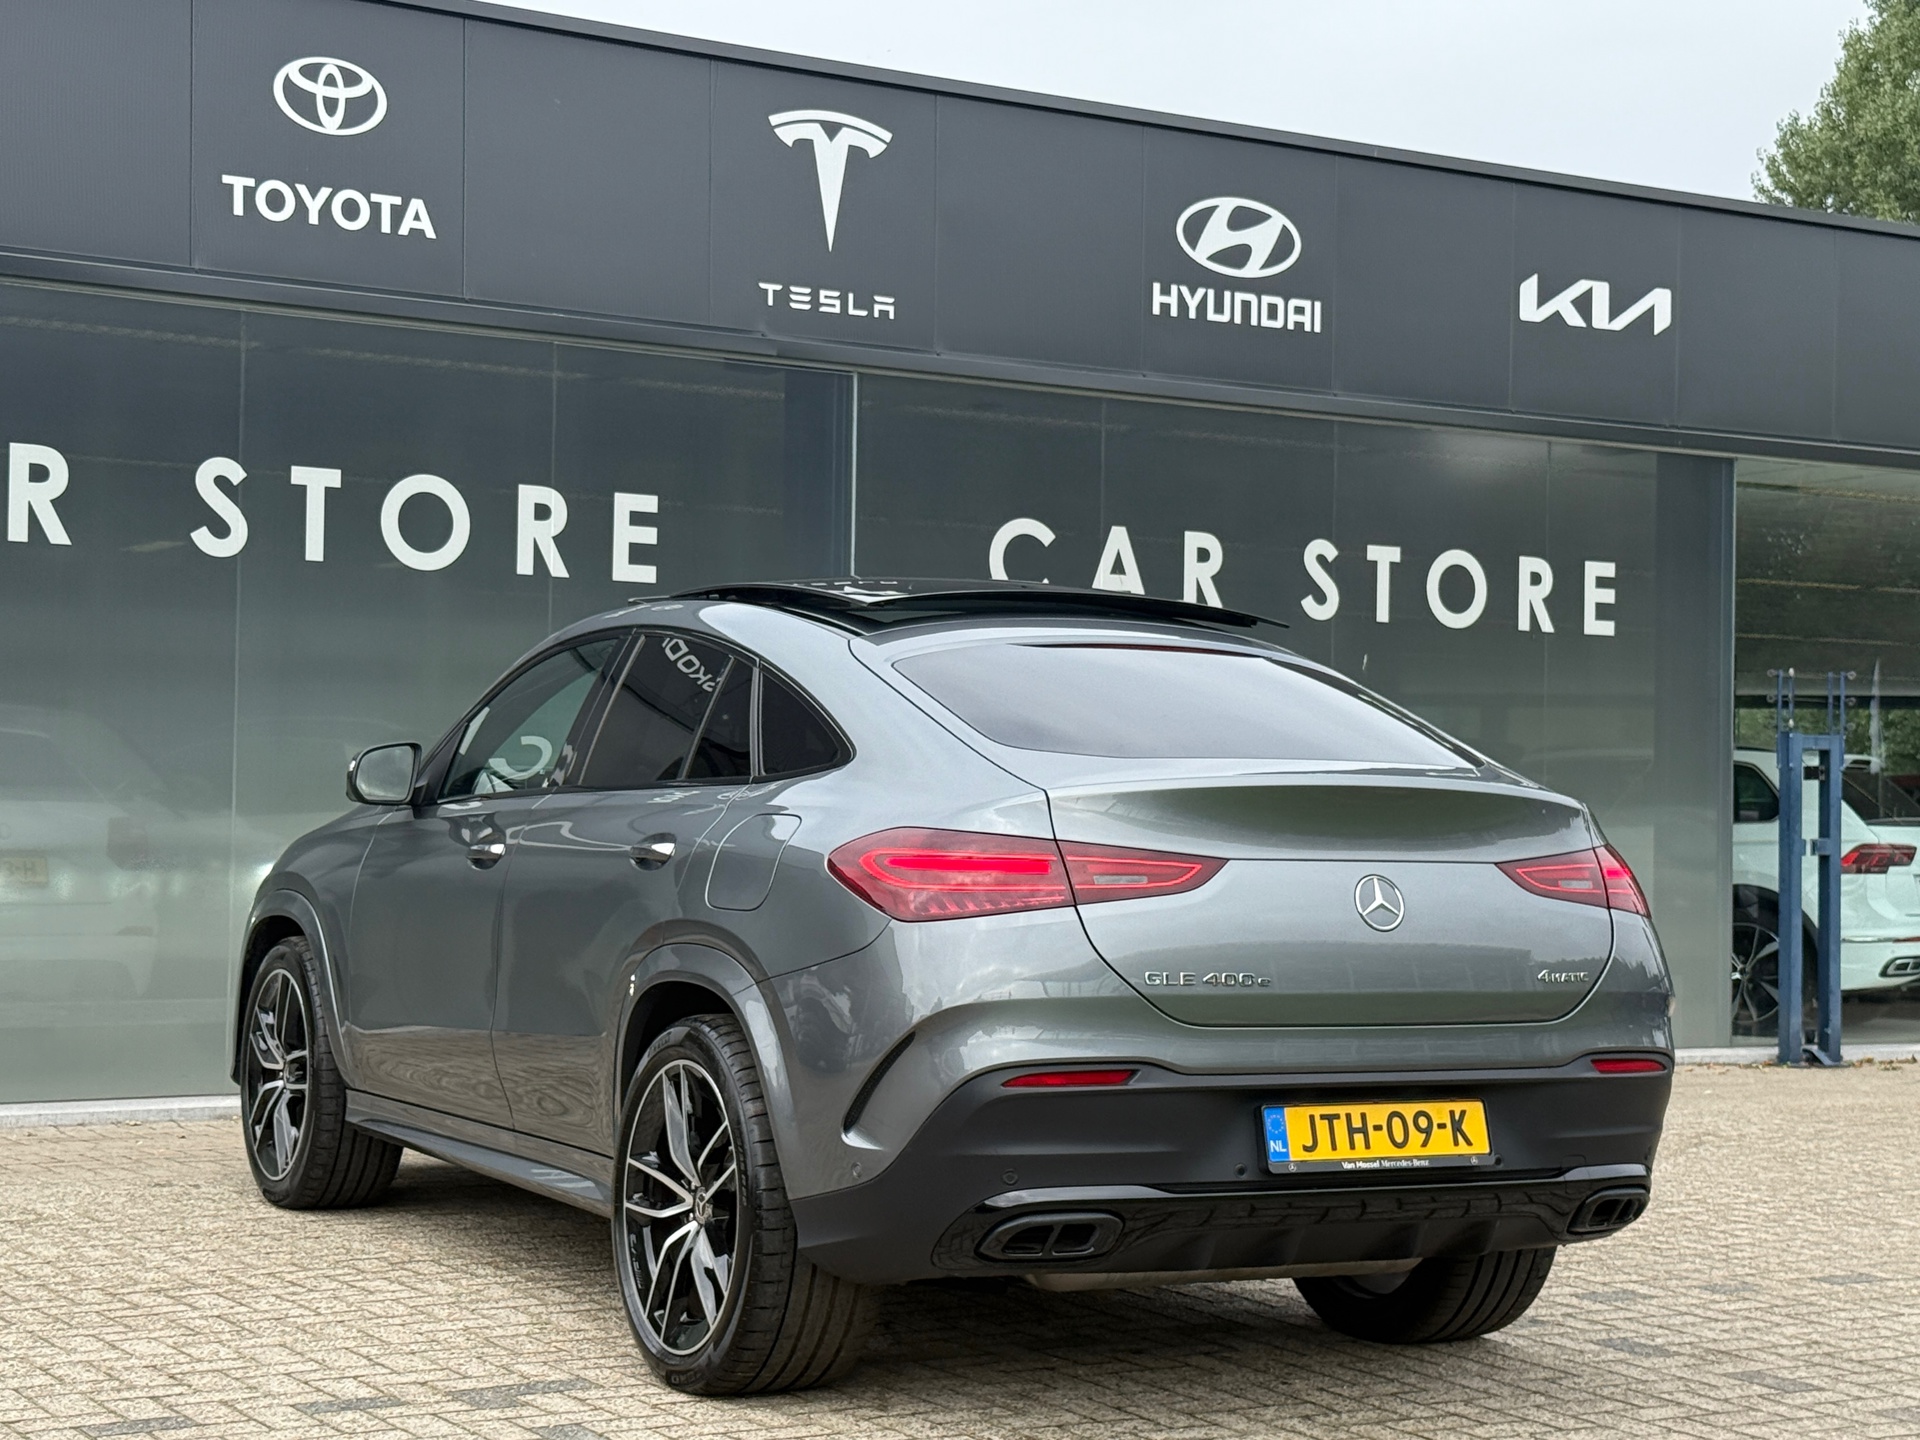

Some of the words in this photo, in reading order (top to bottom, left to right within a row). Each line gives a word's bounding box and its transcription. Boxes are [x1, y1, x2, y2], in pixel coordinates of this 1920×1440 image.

[222, 174, 436, 240] TOYOTA
[758, 281, 895, 320] TESLA
[1152, 282, 1322, 333] HYUNDAI
[1519, 273, 1672, 335] KIA
[190, 456, 659, 583] STORE
[989, 517, 1223, 607] CAR
[1300, 538, 1617, 637] STORE
[1144, 971, 1196, 986] GLE
[1270, 1139, 1287, 1153] NL
[1302, 1109, 1473, 1153] JTH-09-K
[1341, 1161, 1355, 1169] Van
[1381, 1159, 1429, 1168] Mercedes-Benz
